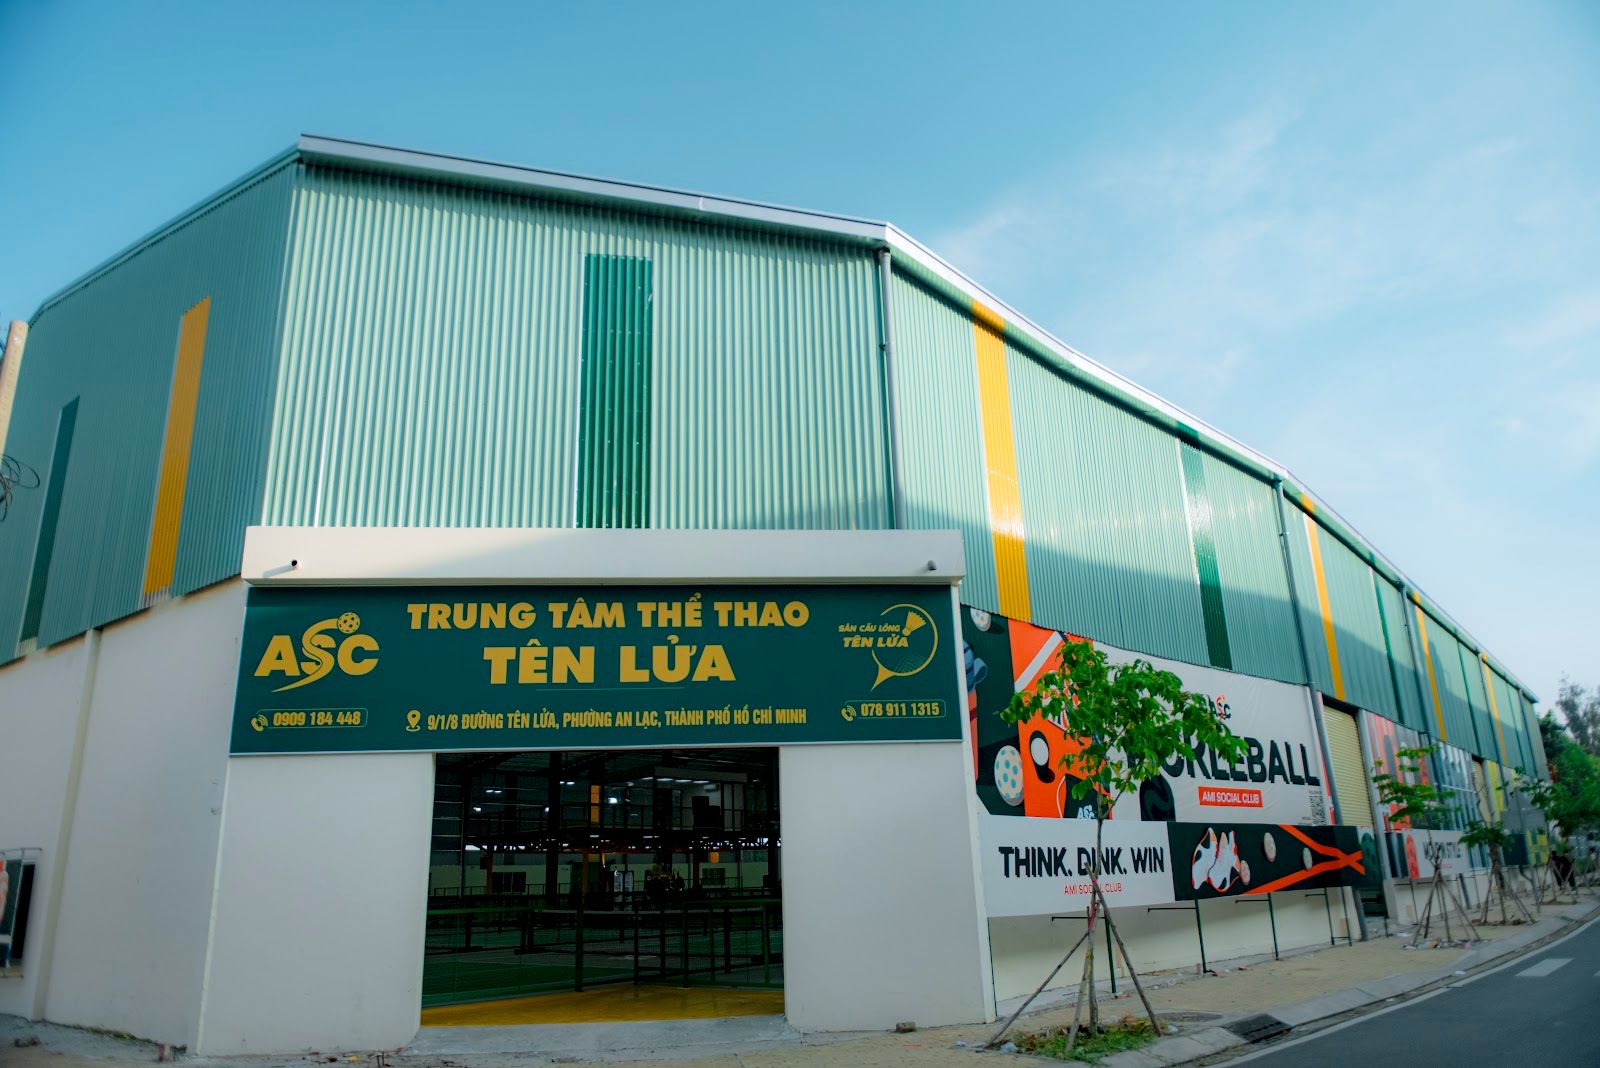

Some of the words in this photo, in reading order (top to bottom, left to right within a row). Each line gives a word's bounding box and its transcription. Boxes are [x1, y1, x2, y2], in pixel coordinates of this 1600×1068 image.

[406, 602, 537, 630] TRUNG
[548, 597, 626, 629] TÂM
[637, 592, 702, 628] THỂ
[714, 601, 810, 628] THAO
[843, 634, 874, 648] TÊN
[253, 617, 380, 692] ASC
[483, 639, 595, 685] TÊN
[619, 634, 736, 683] LỬA
[272, 712, 306, 727] 0909
[309, 711, 333, 726] 184
[336, 711, 361, 726] 448
[427, 713, 459, 731] 9/1/8
[461, 710, 504, 730] ĐƯỜNG
[507, 709, 530, 729] TÊN
[533, 707, 560, 730] LỬA,
[563, 708, 613, 728] PHƯỜNG
[615, 711, 633, 727] AN
[636, 711, 662, 730] LẠC,
[665, 707, 704, 726] THÀNH
[707, 704, 731, 725] PHỐ
[752, 706, 773, 725] CHÍ
[775, 708, 807, 725] MINH
[861, 703, 884, 717] 078
[886, 703, 907, 717] 911
[911, 703, 940, 716] 1315
[1202, 791, 1216, 802] AMI
[1216, 791, 1242, 803] SOCIAL
[1241, 793, 1260, 804] CLUB
[998, 846, 1073, 878] THINK.
[1130, 846, 1165, 874] WIN
[1064, 884, 1078, 895] AMI
[1078, 883, 1104, 895] SOCL
[1104, 882, 1122, 893] CLUB
